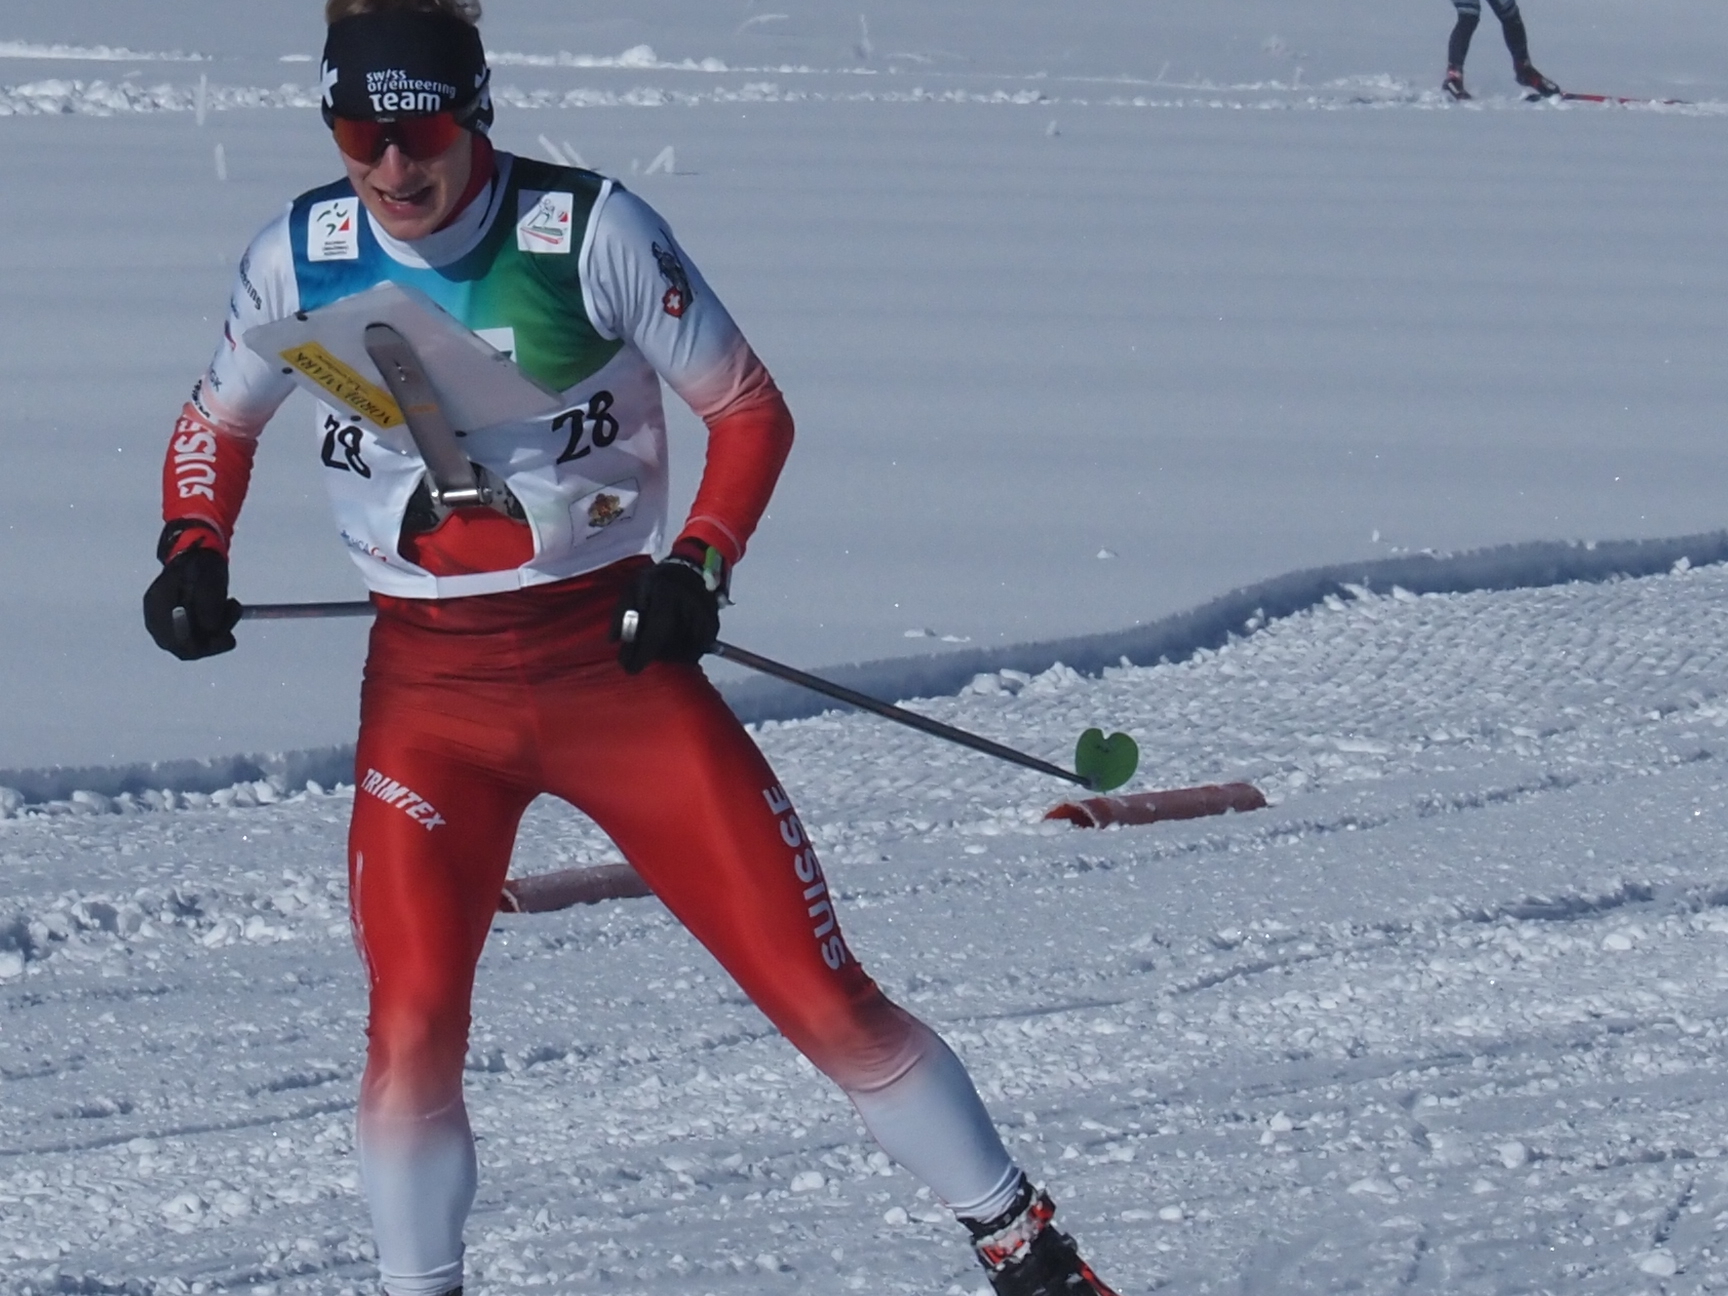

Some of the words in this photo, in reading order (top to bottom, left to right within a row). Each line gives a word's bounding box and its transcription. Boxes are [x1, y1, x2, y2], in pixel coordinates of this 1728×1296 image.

[365, 68, 407, 83] swiss
[367, 78, 456, 99] orienteering
[368, 91, 441, 112] team
[321, 414, 371, 479] 28
[552, 390, 620, 465] 28
[361, 768, 447, 831] TRIMTEX
[762, 783, 847, 970] SUISSE
